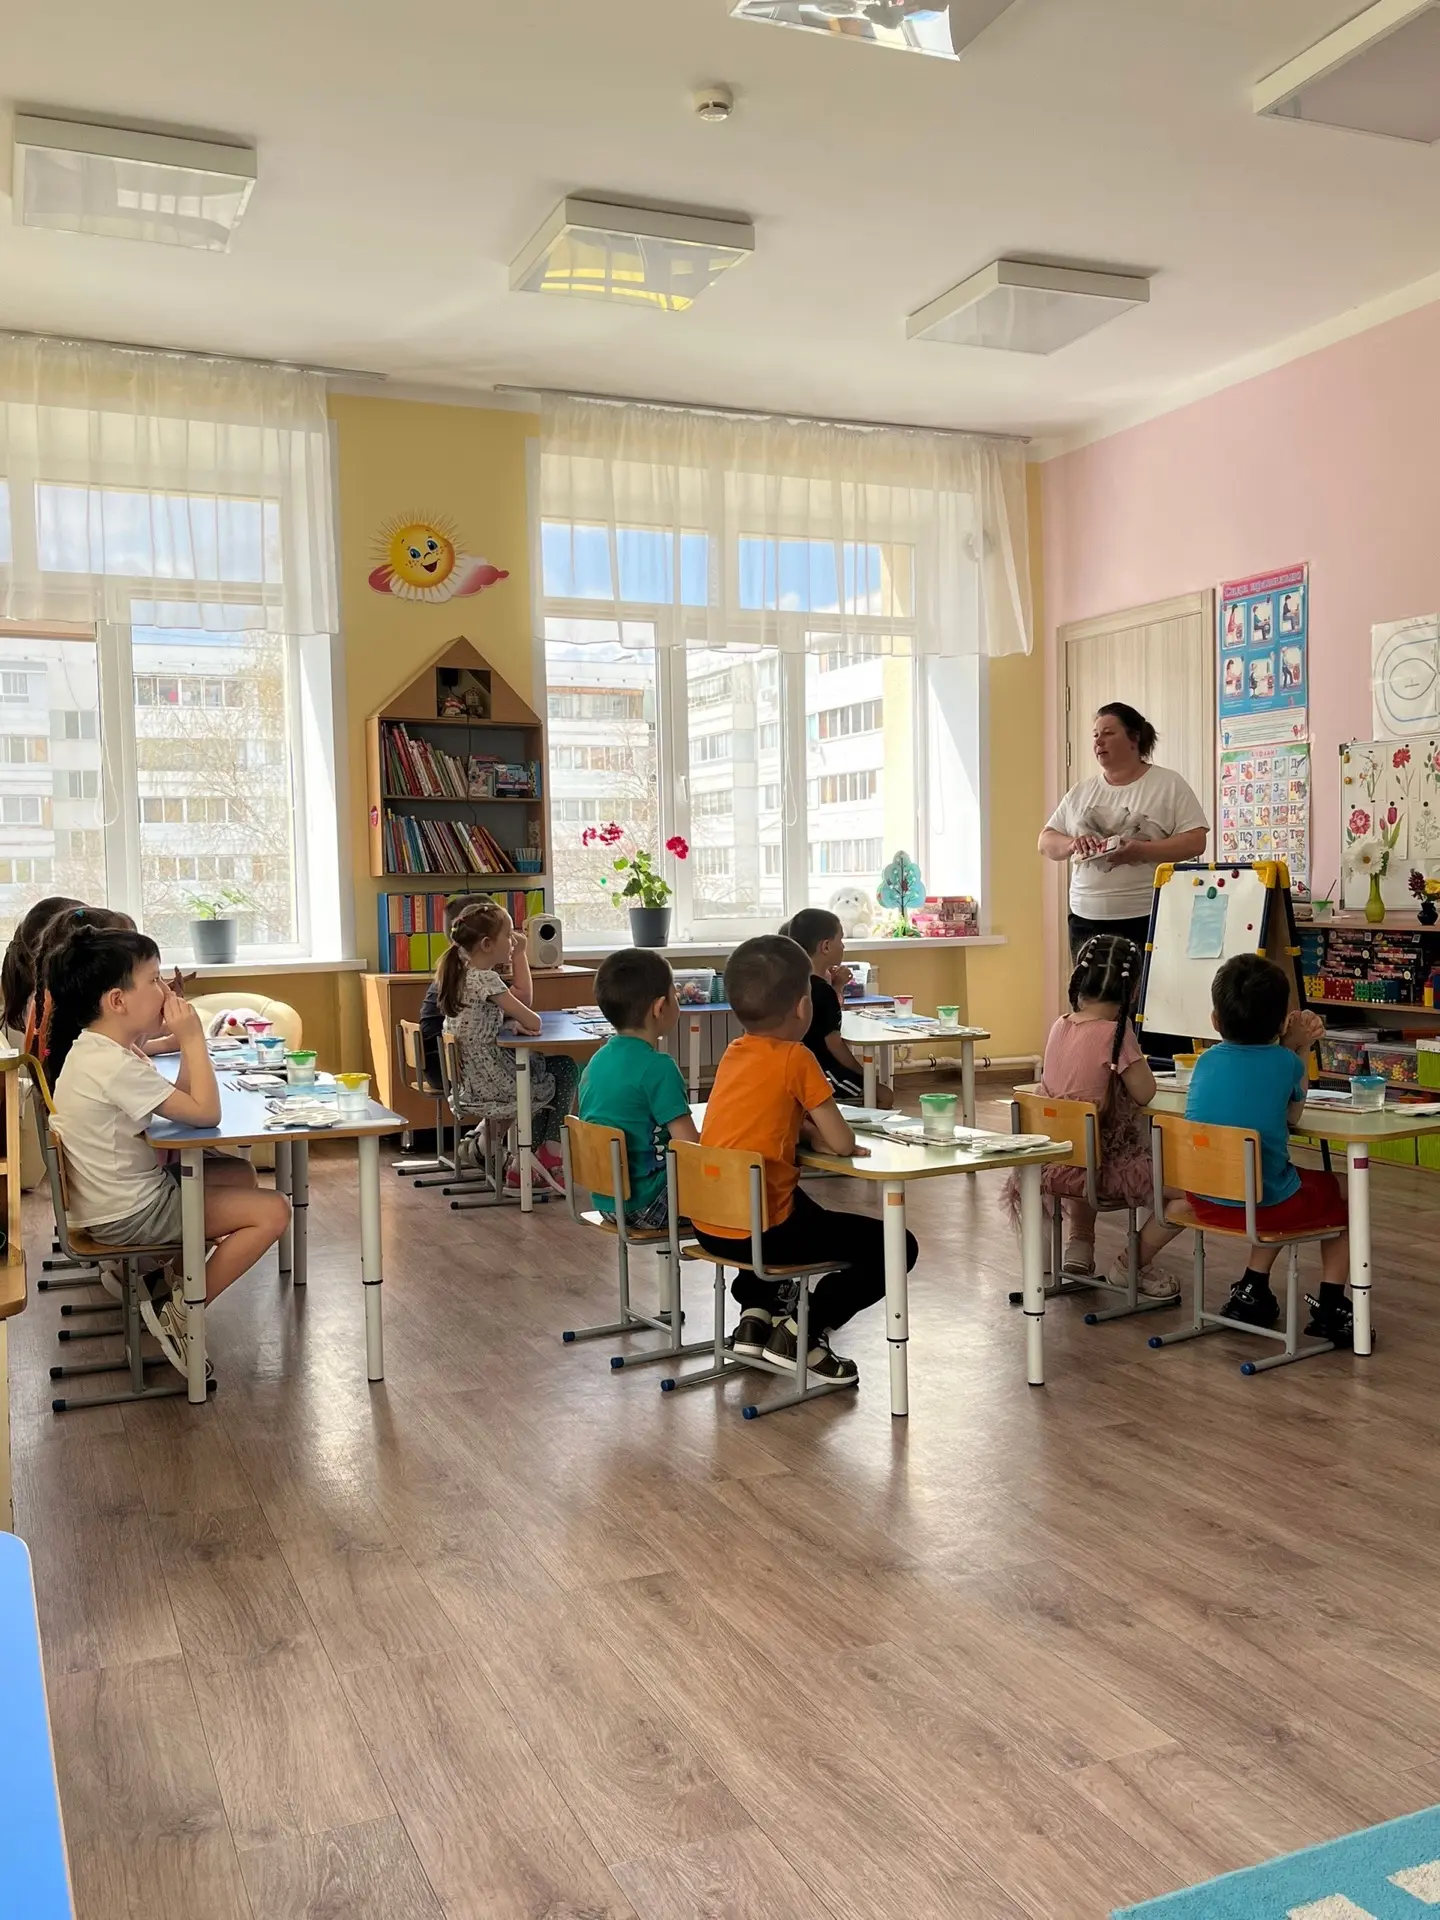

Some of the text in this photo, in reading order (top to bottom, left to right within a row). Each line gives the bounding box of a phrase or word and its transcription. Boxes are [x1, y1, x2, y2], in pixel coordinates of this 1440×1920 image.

[1241, 764, 1246, 774] Б
[1258, 762, 1264, 772] В
[1224, 787, 1229, 796] Е
[1256, 784, 1264, 794] Ж
[1273, 783, 1279, 792] З
[1240, 808, 1245, 818] К
[1256, 807, 1262, 816] Л
[1272, 806, 1280, 816] М
[1290, 805, 1296, 814] Н
[1224, 830, 1296, 842] О П Р С Т
[1290, 854, 1296, 863] Ч
